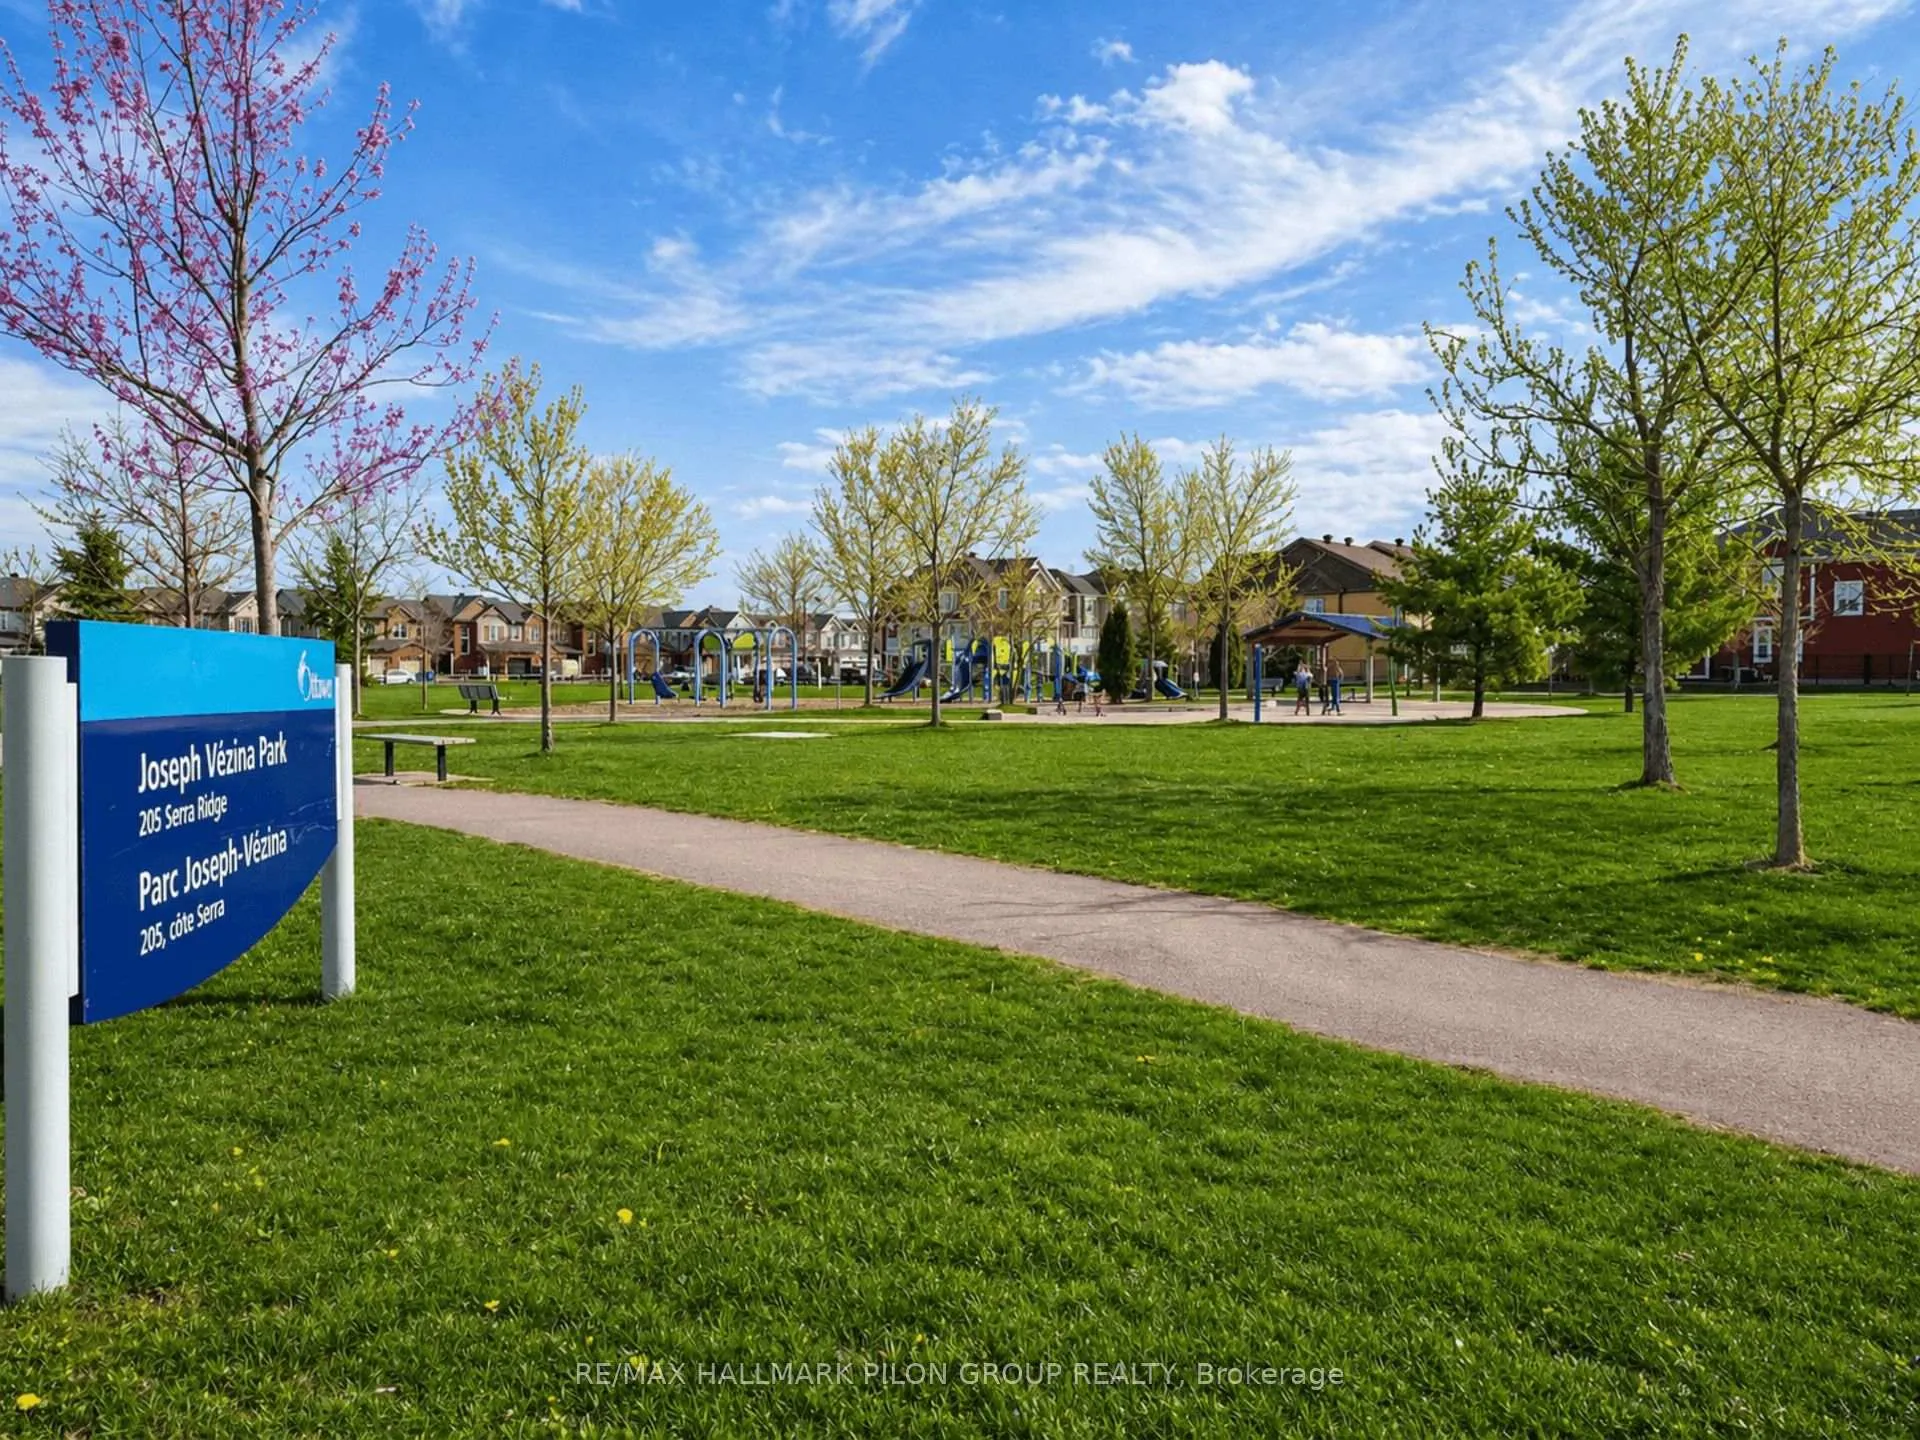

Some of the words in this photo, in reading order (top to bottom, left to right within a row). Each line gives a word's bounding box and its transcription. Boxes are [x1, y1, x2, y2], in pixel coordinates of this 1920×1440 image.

[138, 743, 201, 794] Joseph
[205, 738, 255, 778] Vézina
[259, 731, 287, 768] Park
[139, 806, 162, 837] 205
[165, 804, 195, 830] Serra
[197, 792, 228, 823] Ridge
[139, 871, 179, 912] Parc
[183, 825, 287, 893] Joseph-Vézina
[140, 922, 166, 956] 205,
[197, 899, 225, 928] Serra
